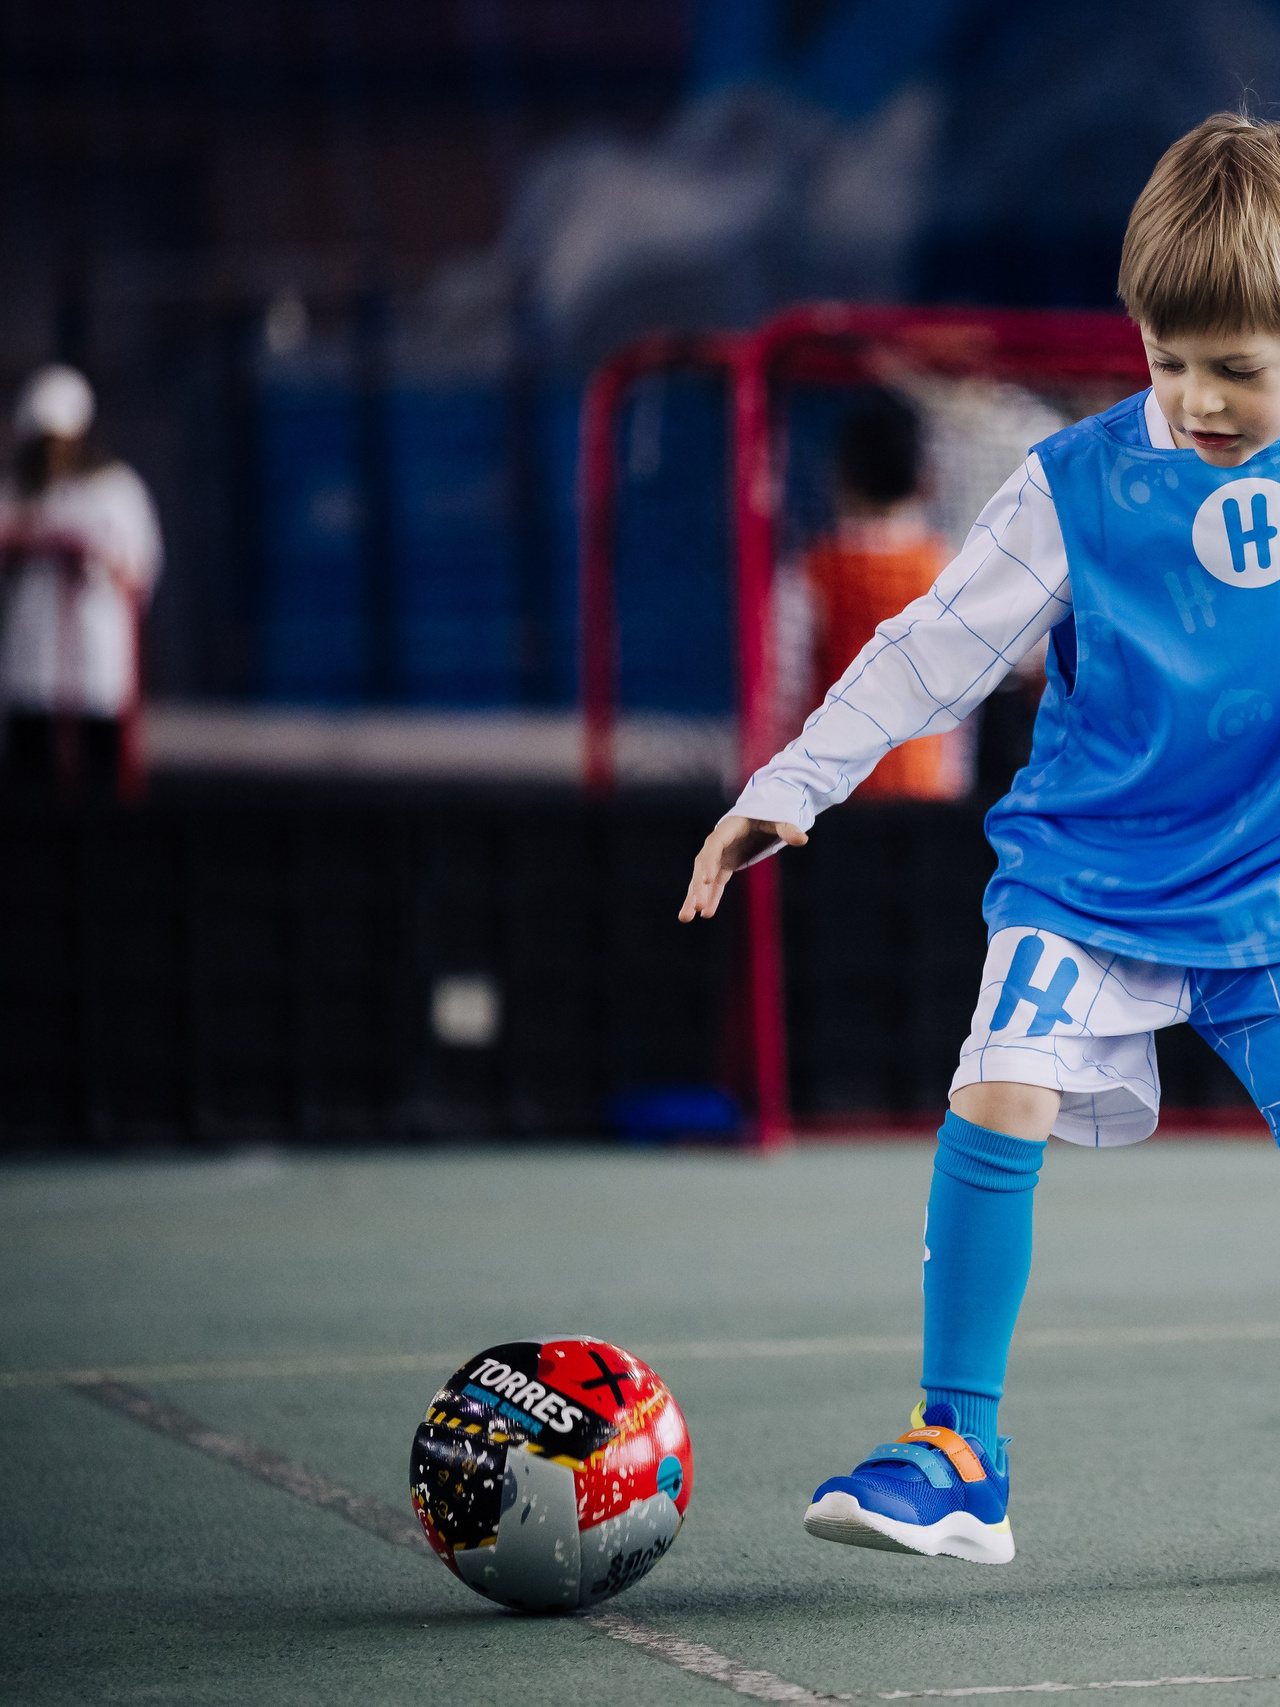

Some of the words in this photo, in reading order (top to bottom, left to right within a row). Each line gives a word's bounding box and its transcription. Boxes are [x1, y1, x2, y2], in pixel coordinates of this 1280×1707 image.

[1222, 493, 1278, 573] H
[1164, 565, 1217, 634] H
[989, 935, 1080, 1037] H
[469, 1358, 583, 1433] TORRES
